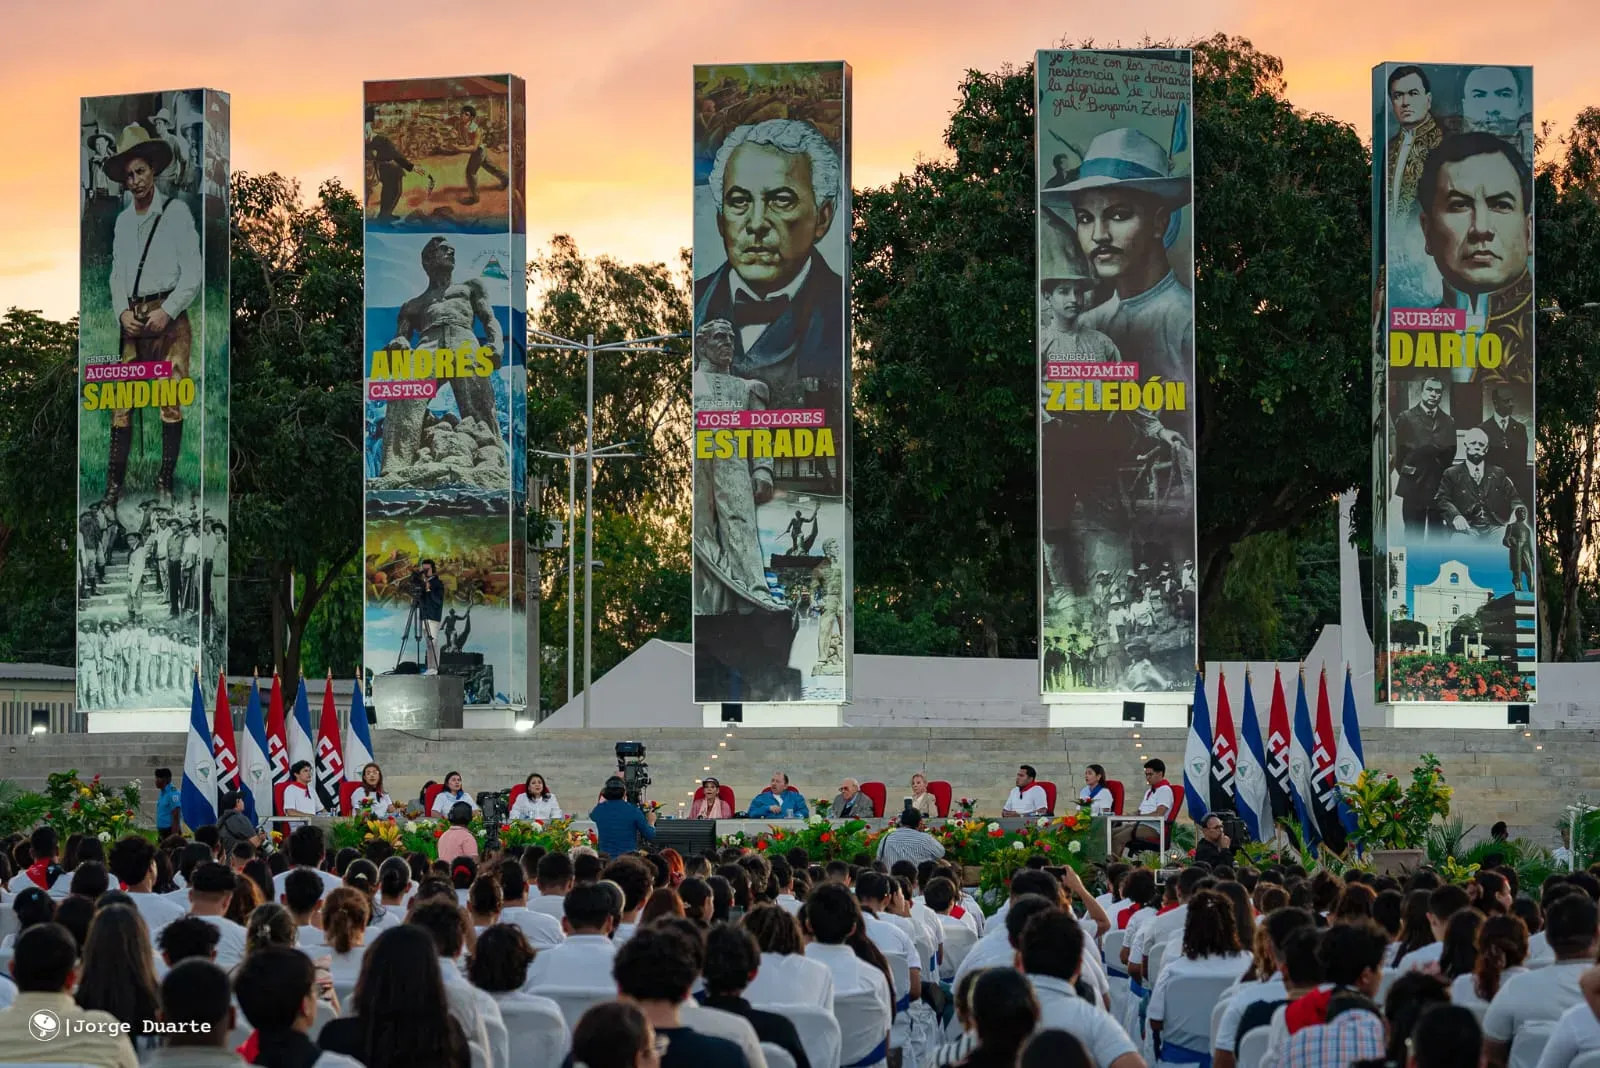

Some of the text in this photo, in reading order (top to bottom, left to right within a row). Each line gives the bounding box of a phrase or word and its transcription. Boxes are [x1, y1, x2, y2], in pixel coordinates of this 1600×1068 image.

[1104, 58, 1122, 69] con
[1126, 56, 1145, 71] los
[1047, 66, 1115, 81] resistencia
[1121, 72, 1141, 89] que
[1045, 78, 1062, 92] la
[1065, 80, 1120, 100] dignidad
[1127, 85, 1144, 98] de
[1393, 308, 1457, 327] RUBÉN
[1389, 325, 1503, 369] DARÍO
[85, 354, 123, 364] GENERAL
[370, 338, 494, 381] ANDRÉS
[1048, 352, 1096, 362] GENERAL
[86, 364, 169, 380] AUGUSTO C.
[1049, 362, 1136, 377] BENJAMÍN
[83, 377, 196, 411] SANDINO
[370, 383, 434, 398] CASTRO
[1045, 376, 1186, 411] ZELEDÓN
[700, 410, 823, 426] JOSÉ DOLORES
[696, 428, 836, 459] ESTRADA
